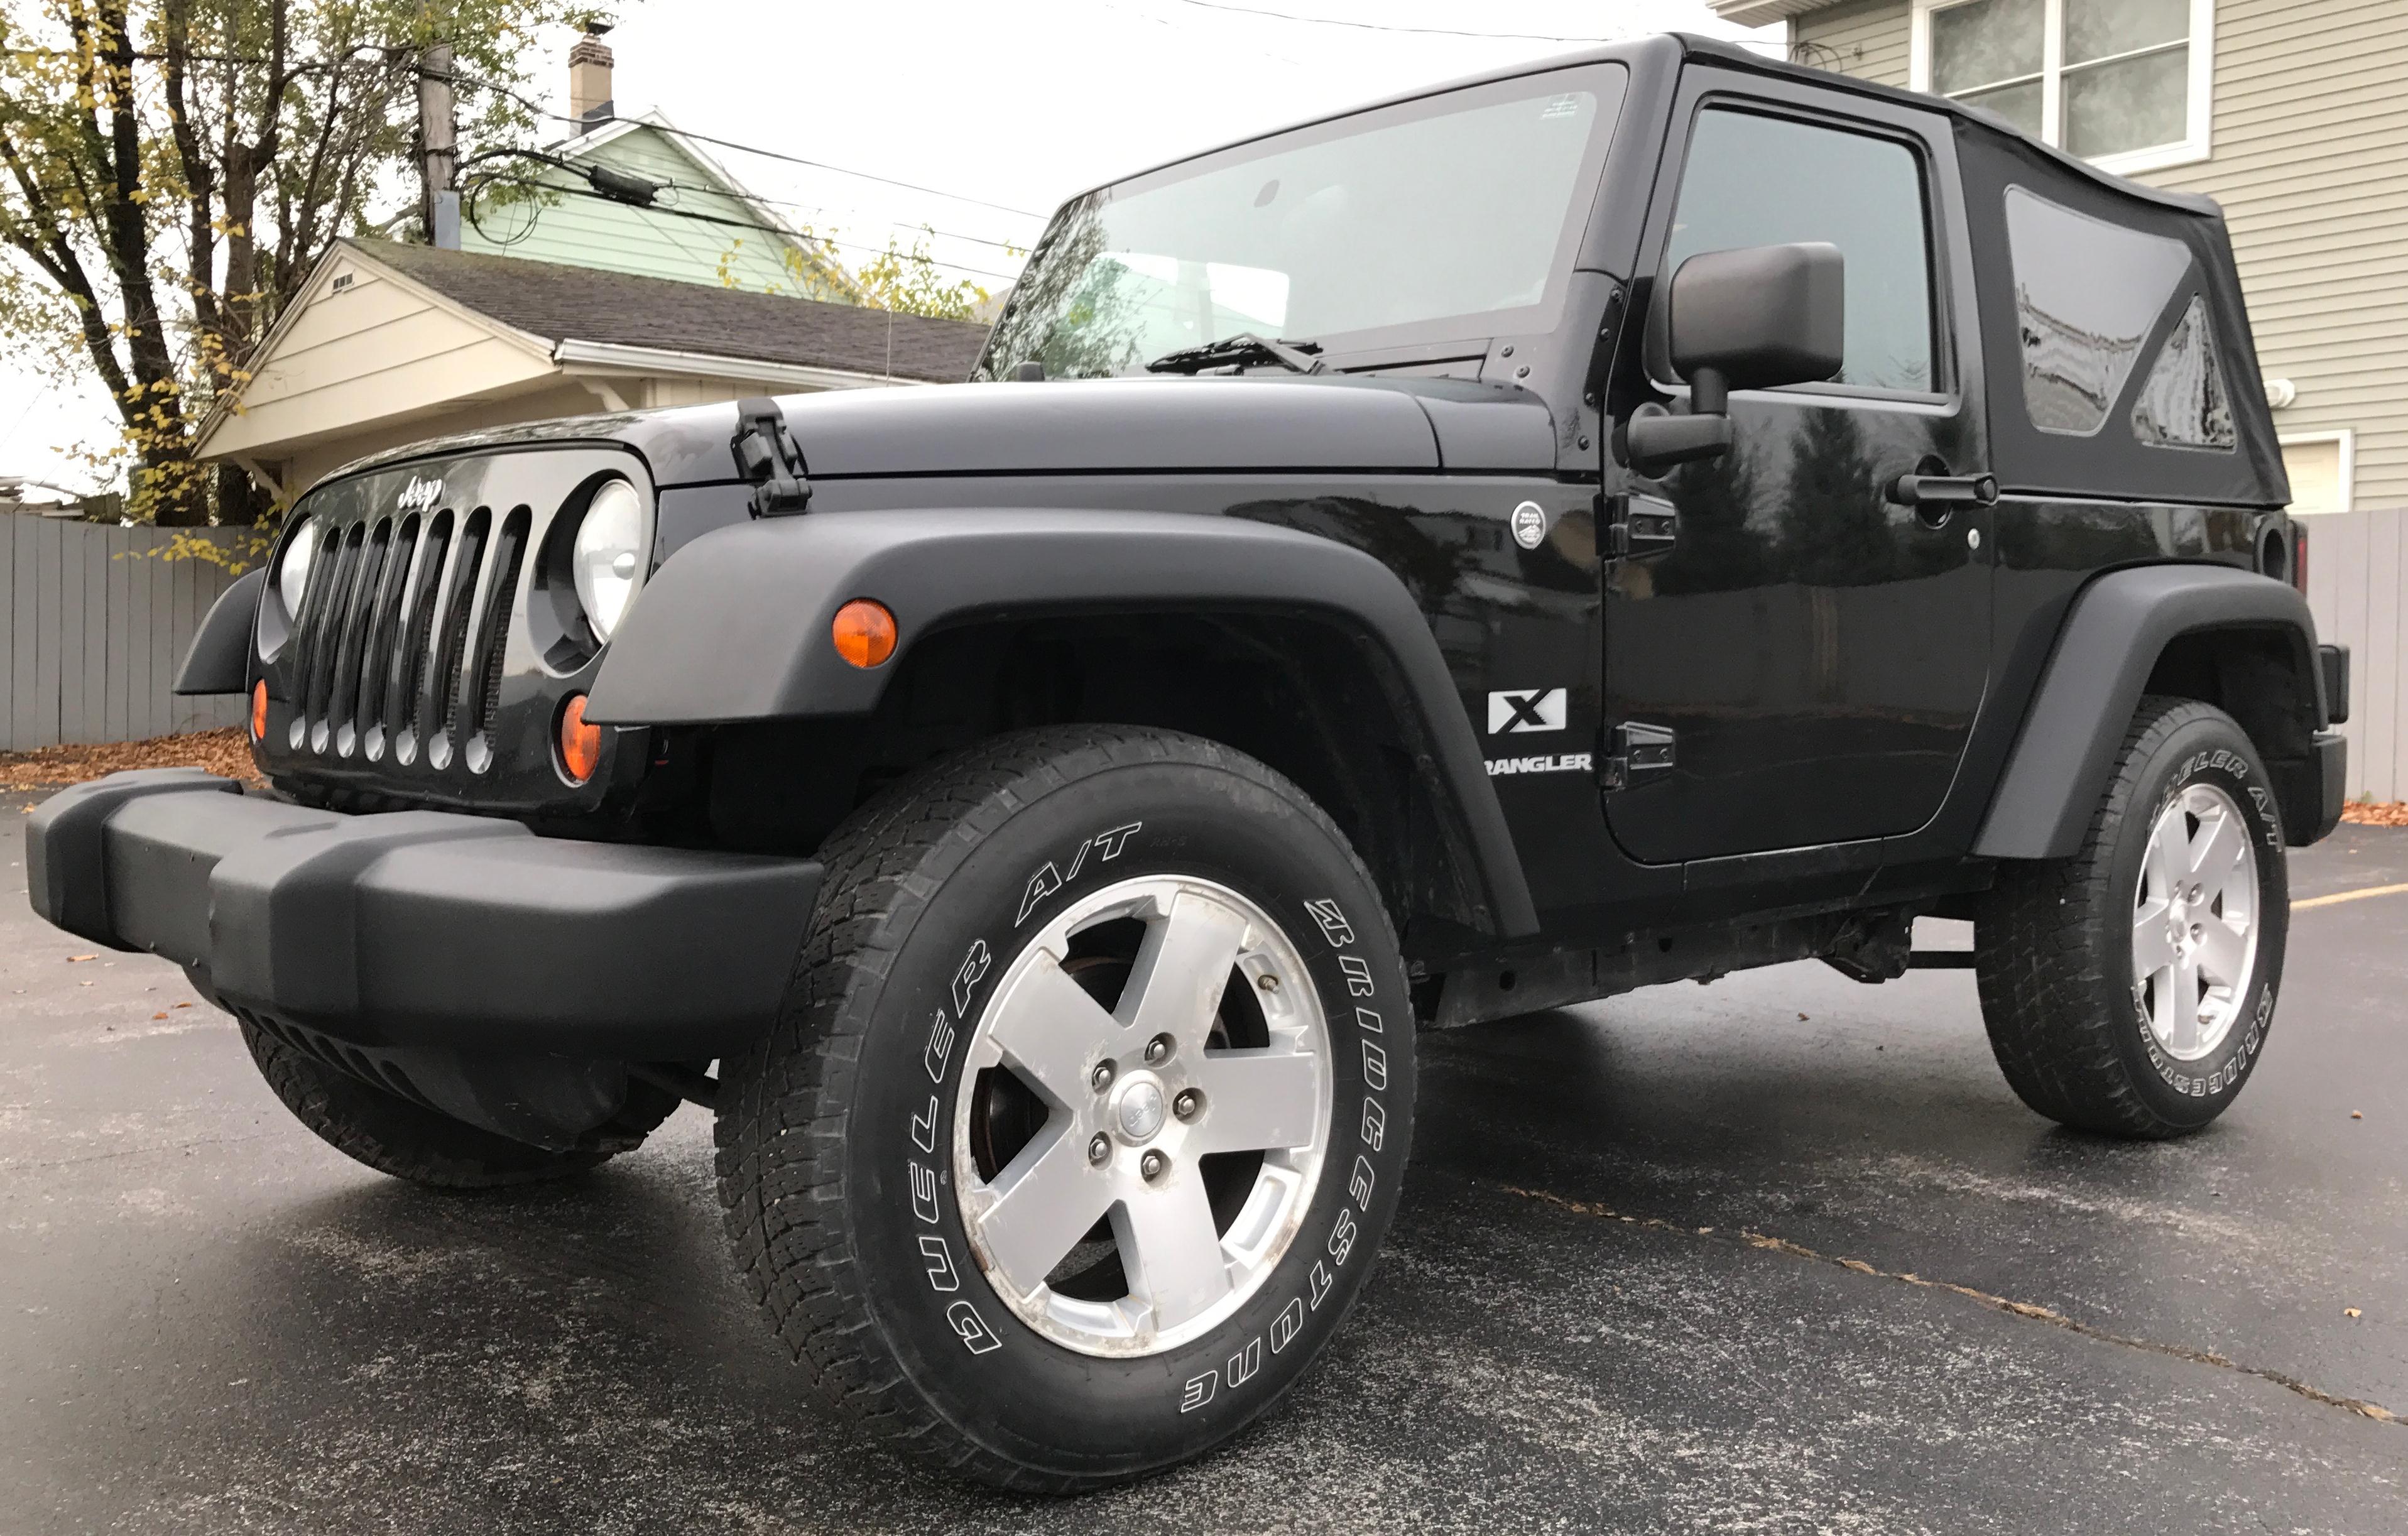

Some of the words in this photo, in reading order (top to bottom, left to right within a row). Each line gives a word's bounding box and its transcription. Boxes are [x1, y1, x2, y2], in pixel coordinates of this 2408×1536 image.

[397, 475, 442, 512] Jeep
[1493, 688, 1559, 734] X
[1483, 753, 1593, 776] RANGLER
[2147, 749, 2248, 836] ELER
[908, 939, 1002, 1355] DUELER
[1014, 821, 1142, 927] A/T
[1179, 898, 1388, 1413] BRIDGESTONE
